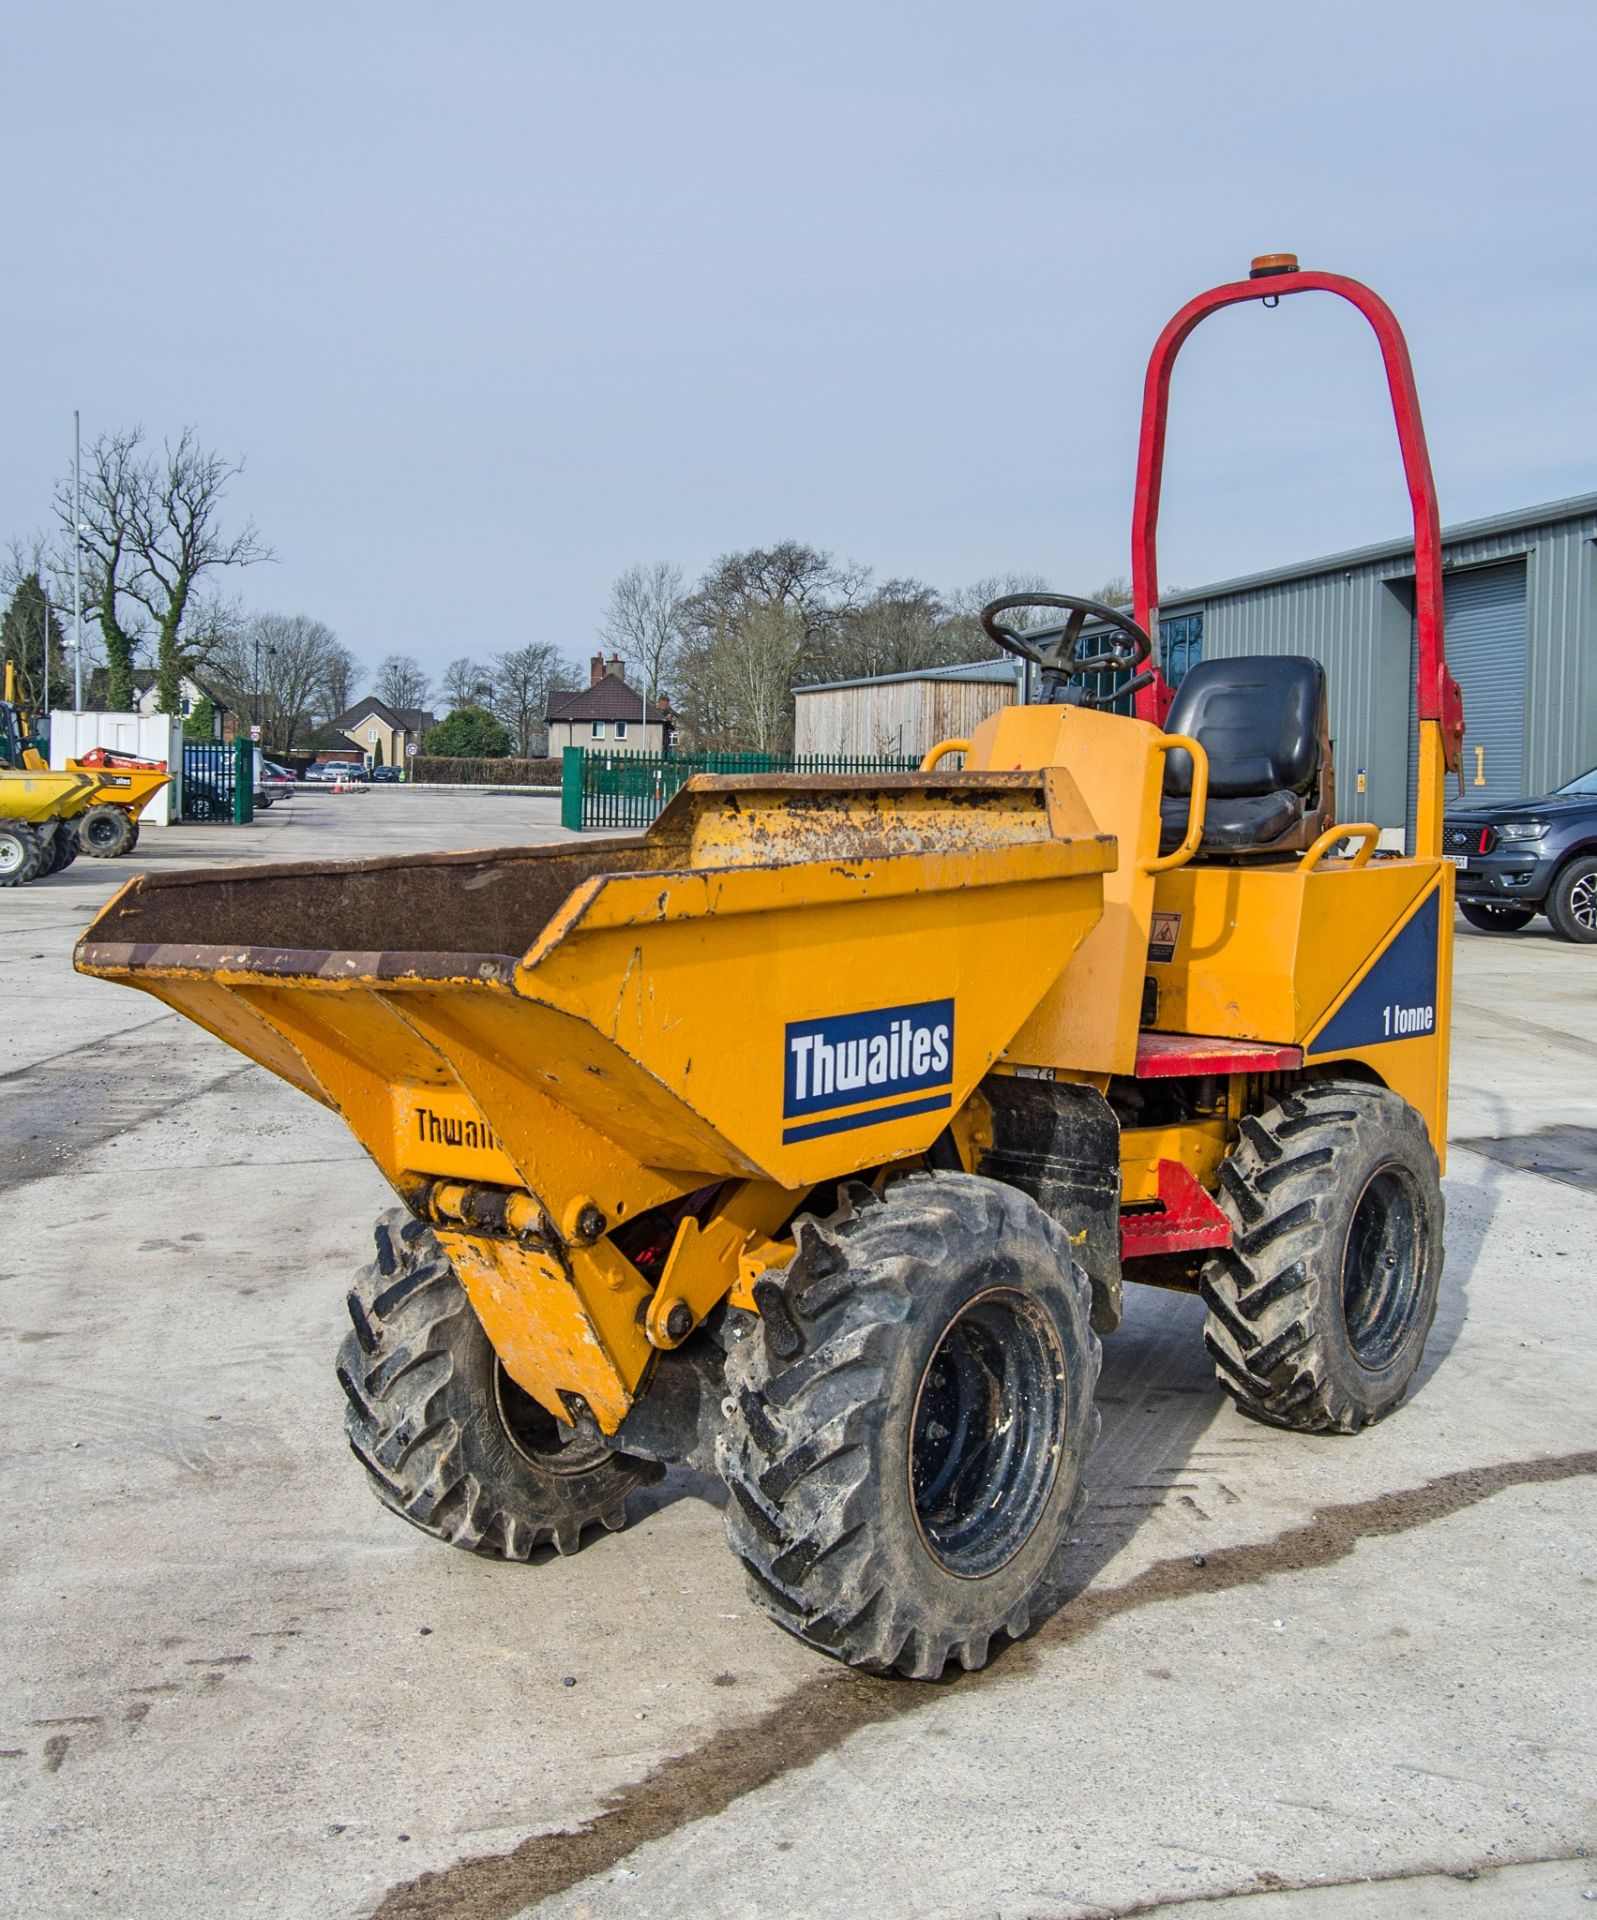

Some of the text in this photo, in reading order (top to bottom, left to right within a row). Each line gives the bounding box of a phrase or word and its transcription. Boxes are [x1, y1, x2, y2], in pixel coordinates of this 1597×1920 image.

[1474, 746, 1486, 786] 1
[1383, 1004, 1433, 1036] 1 tonne
[791, 1019, 949, 1101] Thwaites
